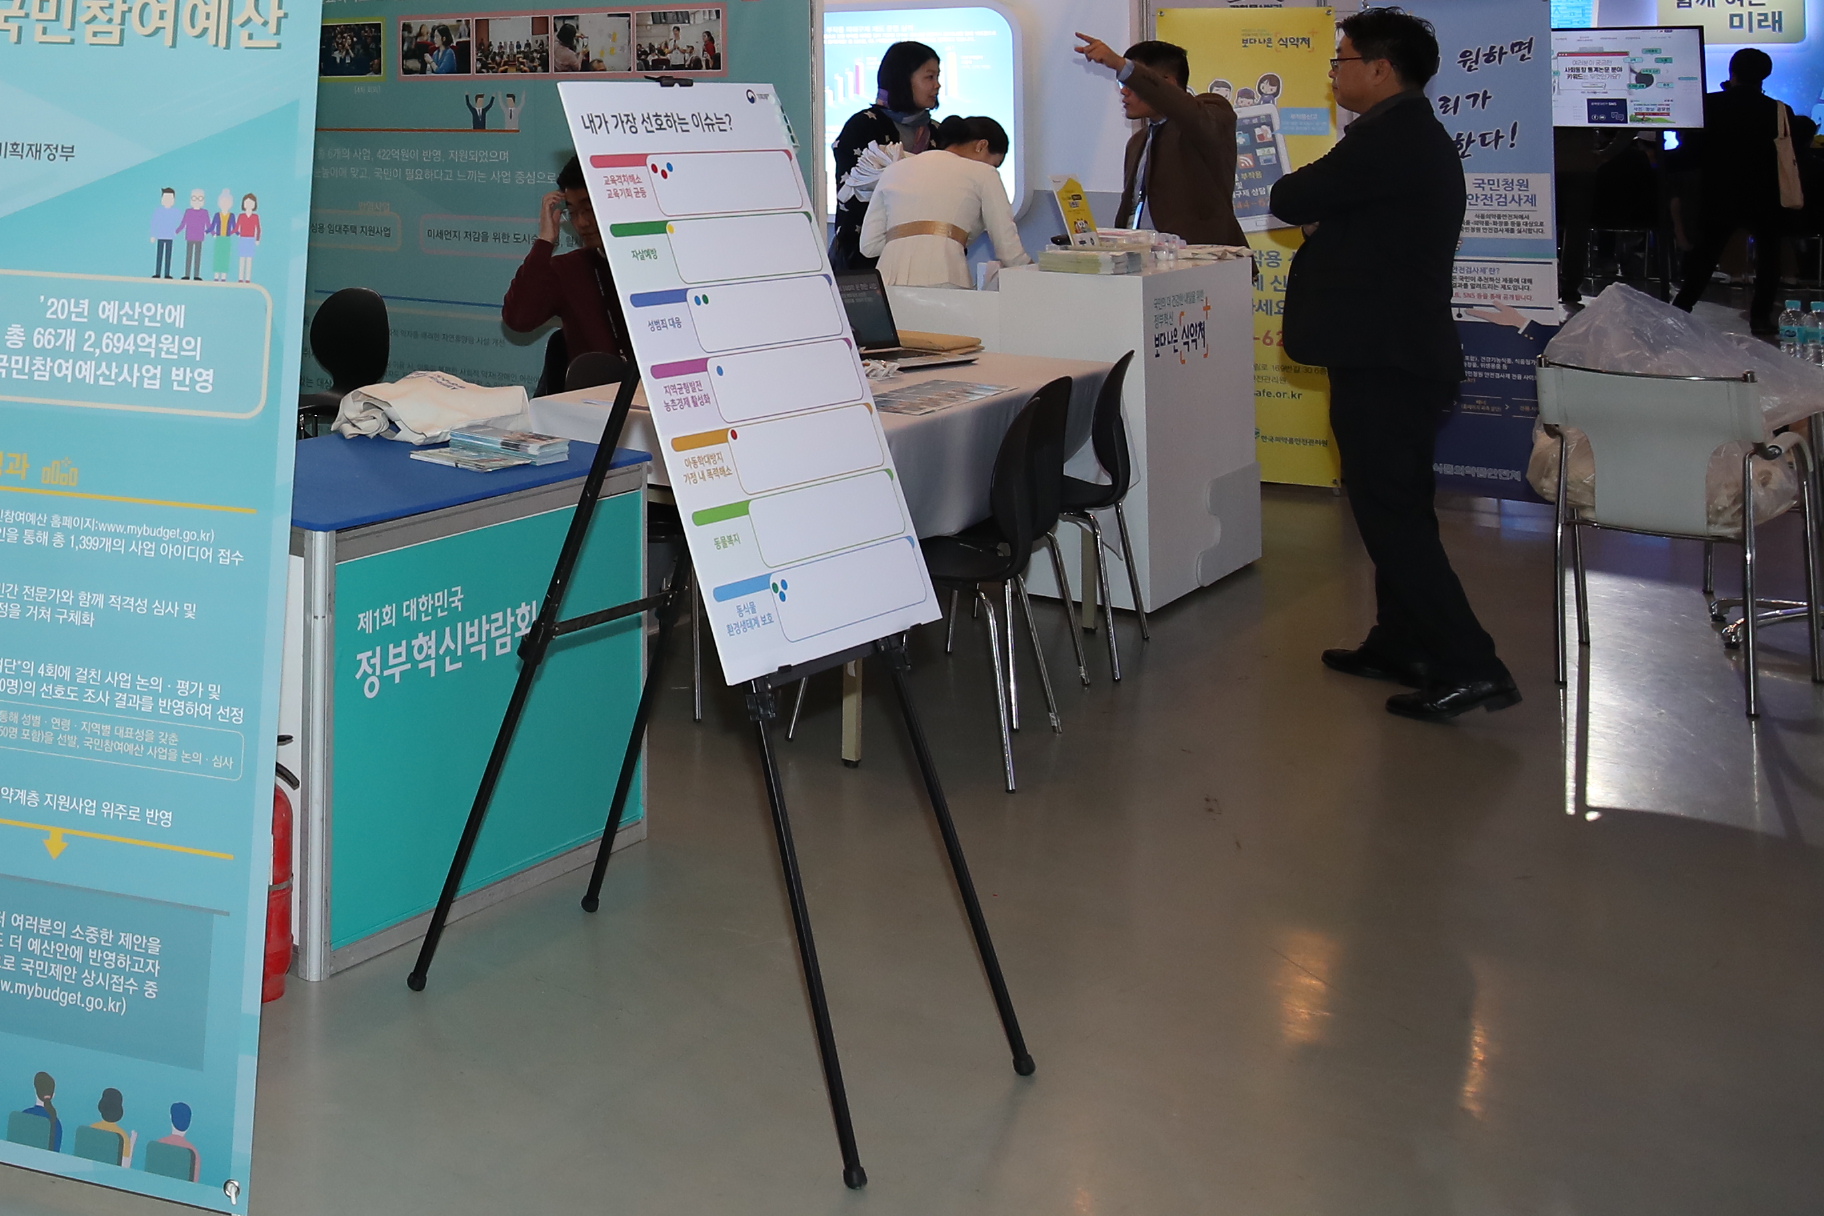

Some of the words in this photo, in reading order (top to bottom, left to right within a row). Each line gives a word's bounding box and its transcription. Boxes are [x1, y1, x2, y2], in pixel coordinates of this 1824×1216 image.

[1729, 11, 1782, 33] 미래
[1278, 37, 1310, 48] 식약처
[1458, 37, 1534, 72] 원하면
[581, 113, 608, 134] 내가
[611, 113, 638, 134] 가장
[641, 112, 690, 133] 선호하는
[691, 112, 732, 132] 이슈는?
[604, 175, 642, 185] 교육격차해소
[1473, 178, 1529, 192] 국민청원
[607, 189, 633, 199] 교육기회
[634, 188, 647, 198] 균등
[1467, 193, 1536, 206] 안전검사제
[631, 249, 658, 260] 자살예방
[98, 301, 185, 330] 예산안에
[648, 319, 667, 332] 성범죄
[669, 317, 682, 328] 대응
[1154, 312, 1173, 329] 정부혁신
[5, 326, 26, 349] 총
[32, 327, 75, 352] 66개
[83, 332, 202, 361] 2,694억원의
[1155, 332, 1166, 357] 보다
[1167, 328, 1178, 353] 나은
[1181, 321, 1206, 352] 식약처
[171, 367, 214, 393] 반영
[664, 381, 703, 395] 지역균형발전
[684, 452, 723, 468] 아동학대방지
[50, 511, 214, 543] 홈페이지:www.mybudget.go.kr)
[714, 533, 740, 550] 동물복지
[357, 604, 396, 634] 제1회
[403, 586, 464, 622] 대한민국
[355, 600, 538, 699] 정부혁신박람회
[43, 788, 98, 814] 지원사업
[101, 796, 141, 821] 위주로
[145, 803, 173, 827] 반영
[11, 911, 67, 938] 여러분의
[70, 921, 114, 946] 소중한
[118, 929, 161, 954] 제안을
